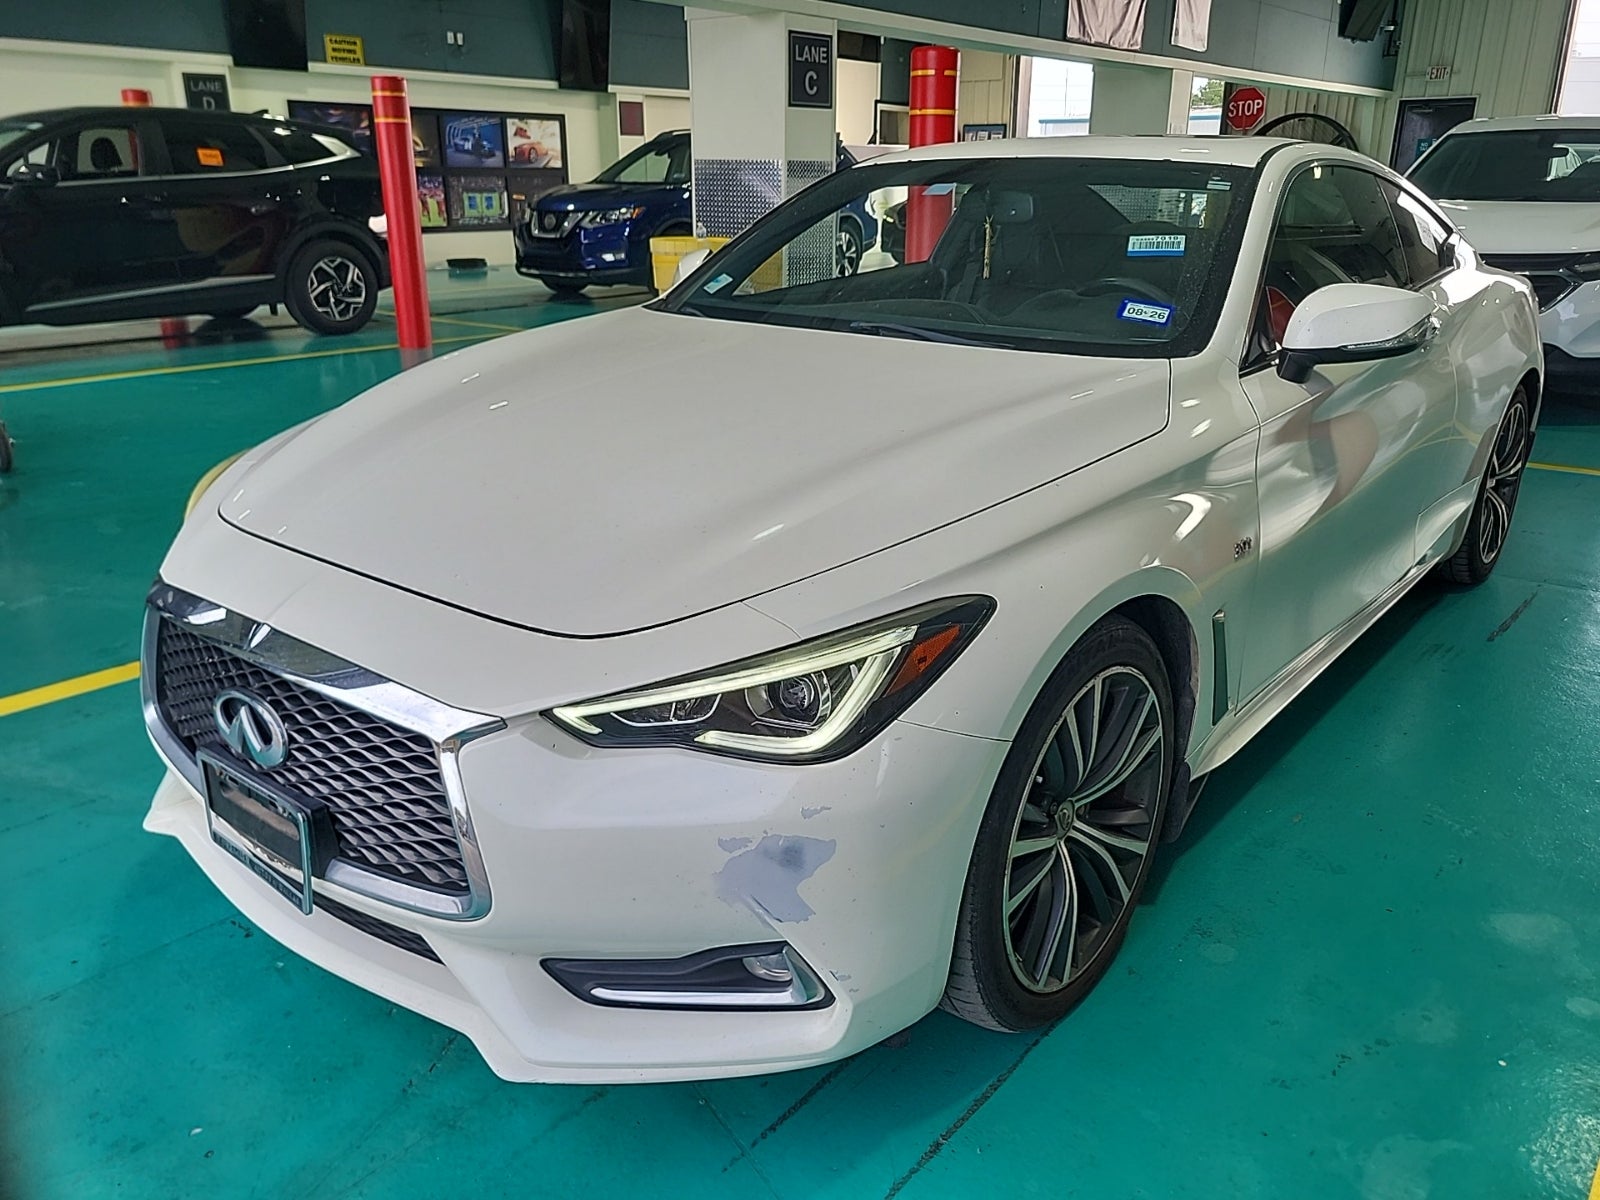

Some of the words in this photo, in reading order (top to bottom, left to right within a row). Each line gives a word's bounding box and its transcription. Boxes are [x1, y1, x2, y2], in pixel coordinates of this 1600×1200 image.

[795, 44, 827, 64] LANE
[1429, 67, 1447, 80] EXIT
[190, 80, 222, 93] LANE
[805, 70, 818, 96] C
[202, 96, 216, 110] D
[1228, 99, 1263, 118] STOP
